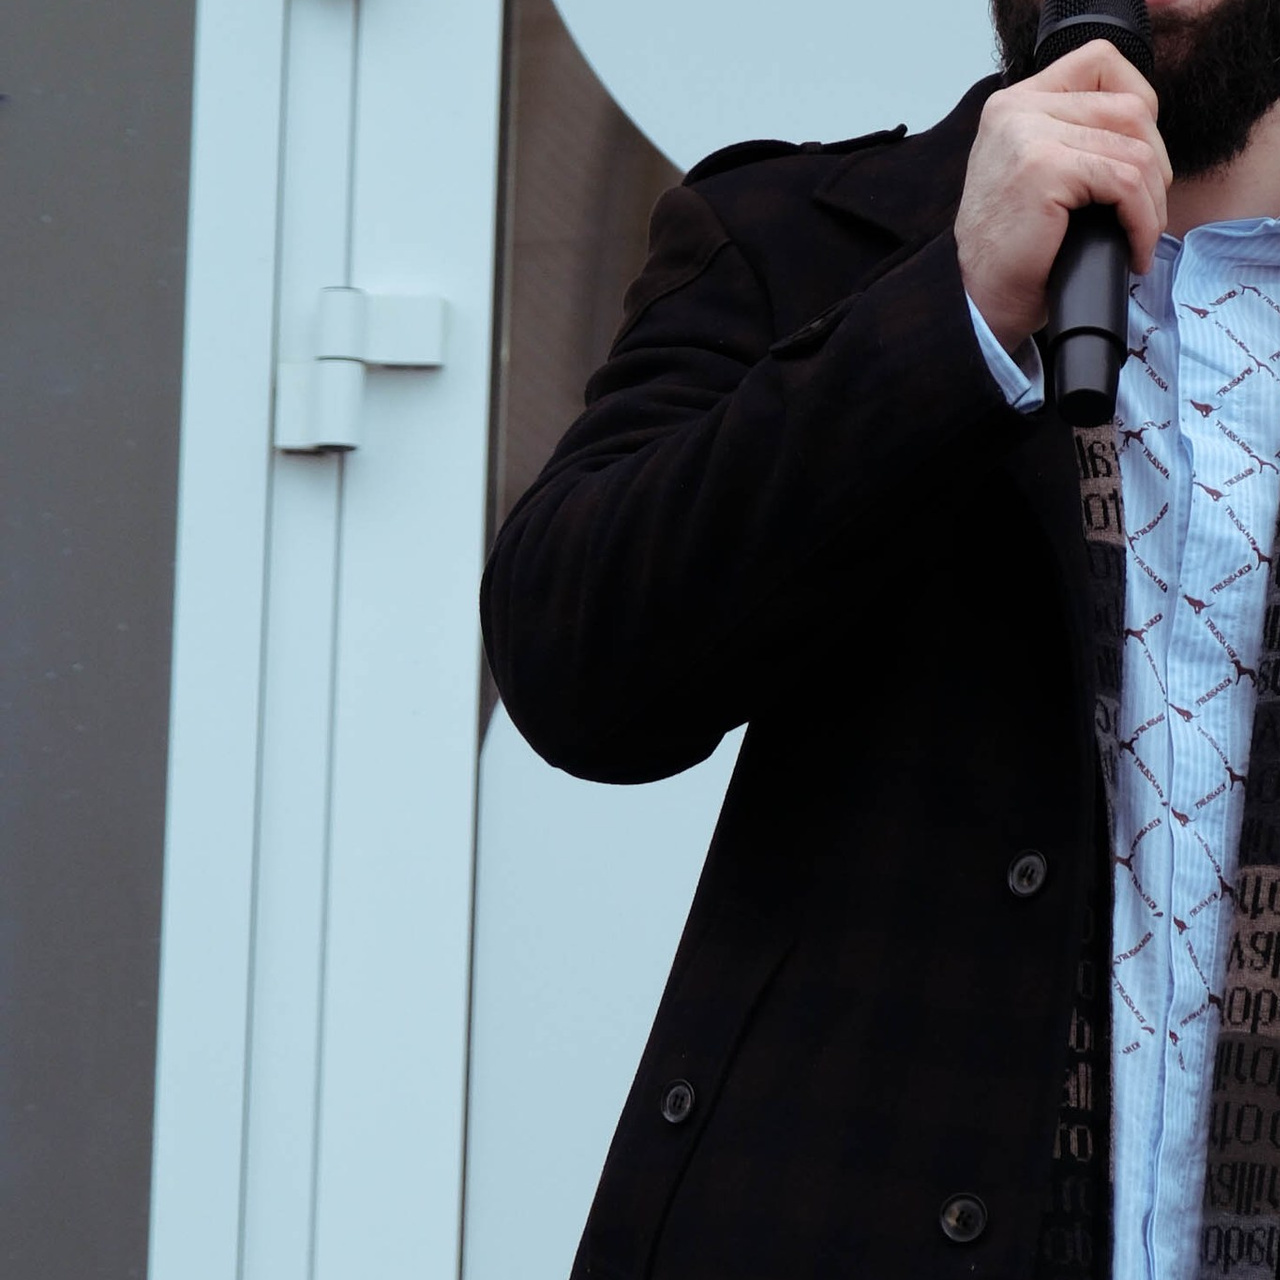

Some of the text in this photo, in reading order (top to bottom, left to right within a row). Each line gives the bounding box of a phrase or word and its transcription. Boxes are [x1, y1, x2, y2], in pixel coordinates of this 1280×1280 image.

[1134, 555, 1168, 593] TRUSSARD
[1210, 564, 1252, 595] TRUSSARDI
[1205, 617, 1238, 659] TRUSSARDI
[1195, 676, 1233, 707] TRUSSARDI
[1114, 981, 1146, 1023] TRUSSARDI
